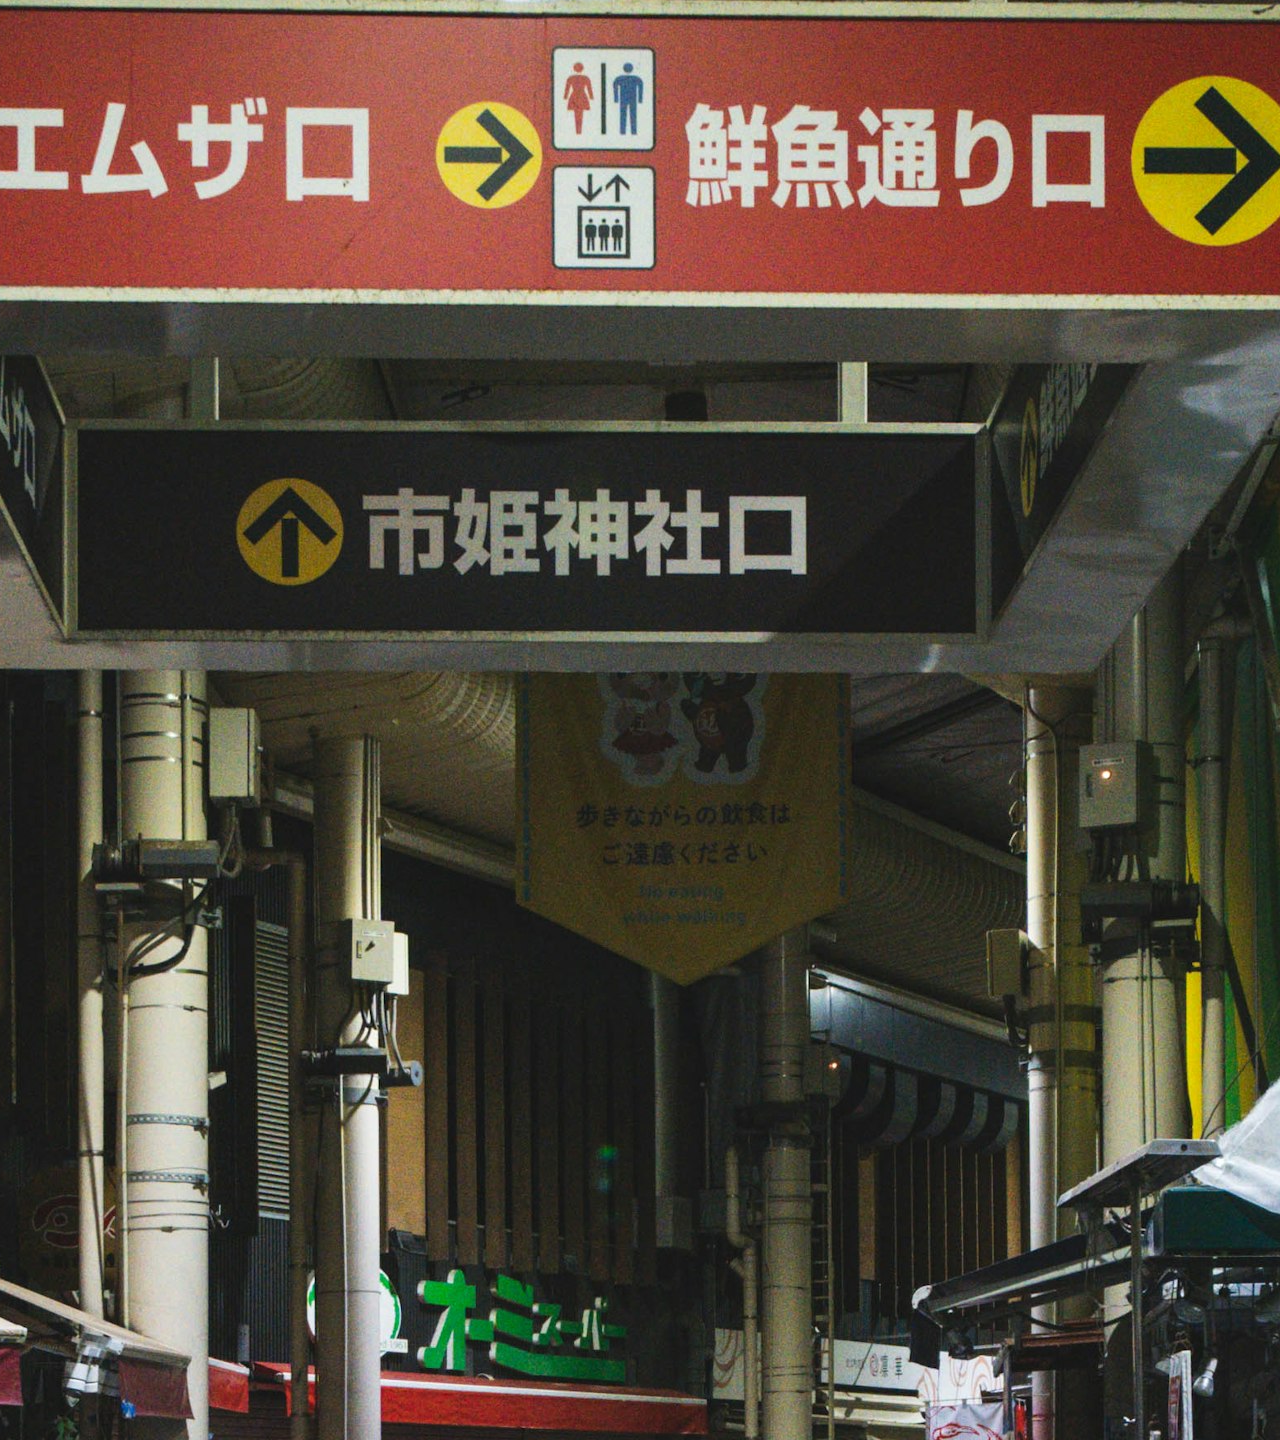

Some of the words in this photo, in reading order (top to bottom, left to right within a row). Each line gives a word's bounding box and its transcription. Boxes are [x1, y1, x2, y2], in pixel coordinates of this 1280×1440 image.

[684, 103, 1108, 210] 鮮魚通り口
[360, 486, 808, 577] 市姫神社口
[576, 803, 792, 829] 歩きながらの飲食は
[601, 841, 768, 866] ご遠慮ください
